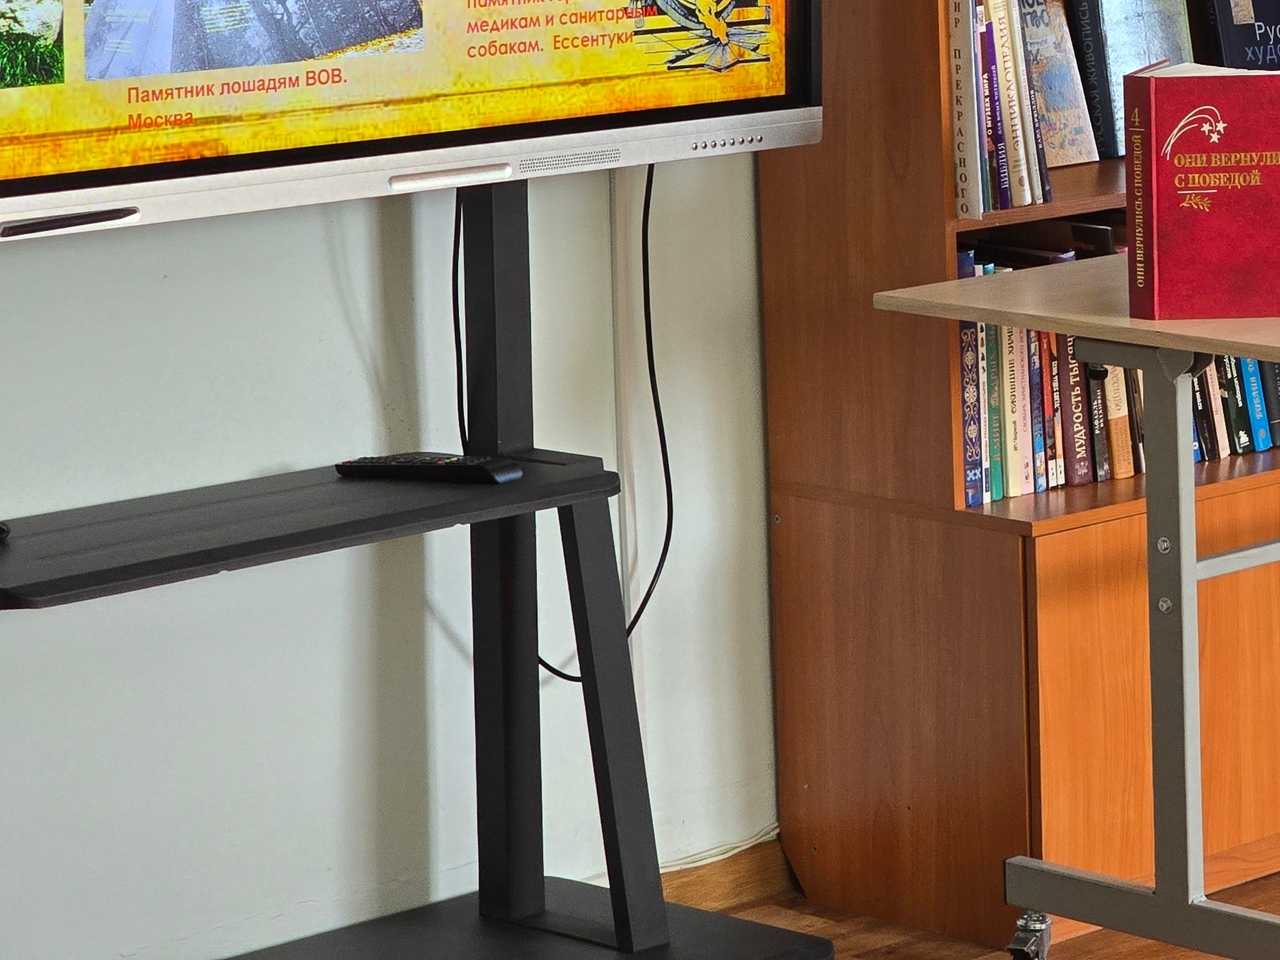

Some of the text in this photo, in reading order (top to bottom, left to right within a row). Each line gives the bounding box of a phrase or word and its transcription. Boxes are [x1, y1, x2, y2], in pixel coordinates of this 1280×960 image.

[466, 4, 658, 34] медикам и санитарным
[466, 31, 635, 58] собакам. Ессентуки
[1078, 1, 1098, 85] ЖИВОПИСЬ
[127, 67, 348, 105] Памятник лошадям ВОВ.
[997, 15, 1020, 151] ЭНЦИКЛОПЕДИЯ
[127, 111, 195, 131] Москва
[983, 96, 992, 128] МУЗЕЯХ
[1130, 107, 1140, 126] 4
[997, 142, 1009, 189] БИБЛИЯ
[1173, 152, 1208, 169] ОНИ
[1174, 169, 1262, 189] С ПОБЕДОЙ
[1131, 134, 1145, 288] ОНИ ВЕРНУЛИСЬ С ПОБЕДОЙ
[1070, 386, 1087, 459] МУДРОСТЬ
